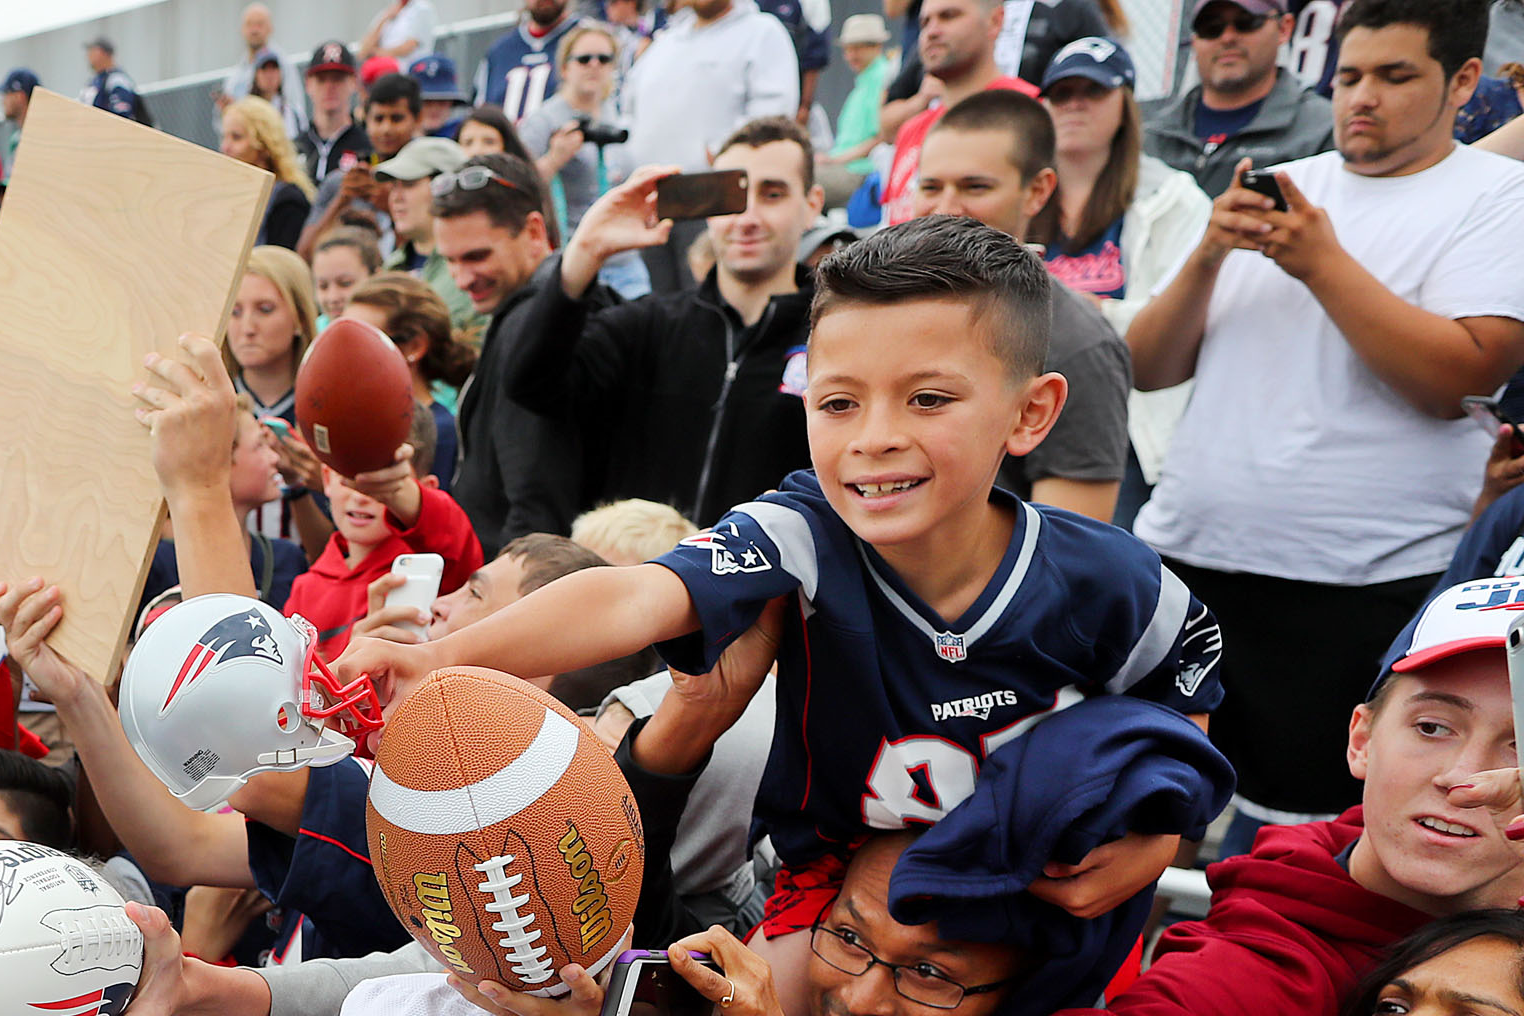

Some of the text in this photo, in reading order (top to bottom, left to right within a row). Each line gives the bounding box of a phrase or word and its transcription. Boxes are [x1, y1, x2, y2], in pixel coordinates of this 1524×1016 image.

[930, 689, 1018, 722] PATRIOTS
[413, 871, 476, 975] Wilson
[557, 825, 613, 956] Wilson
